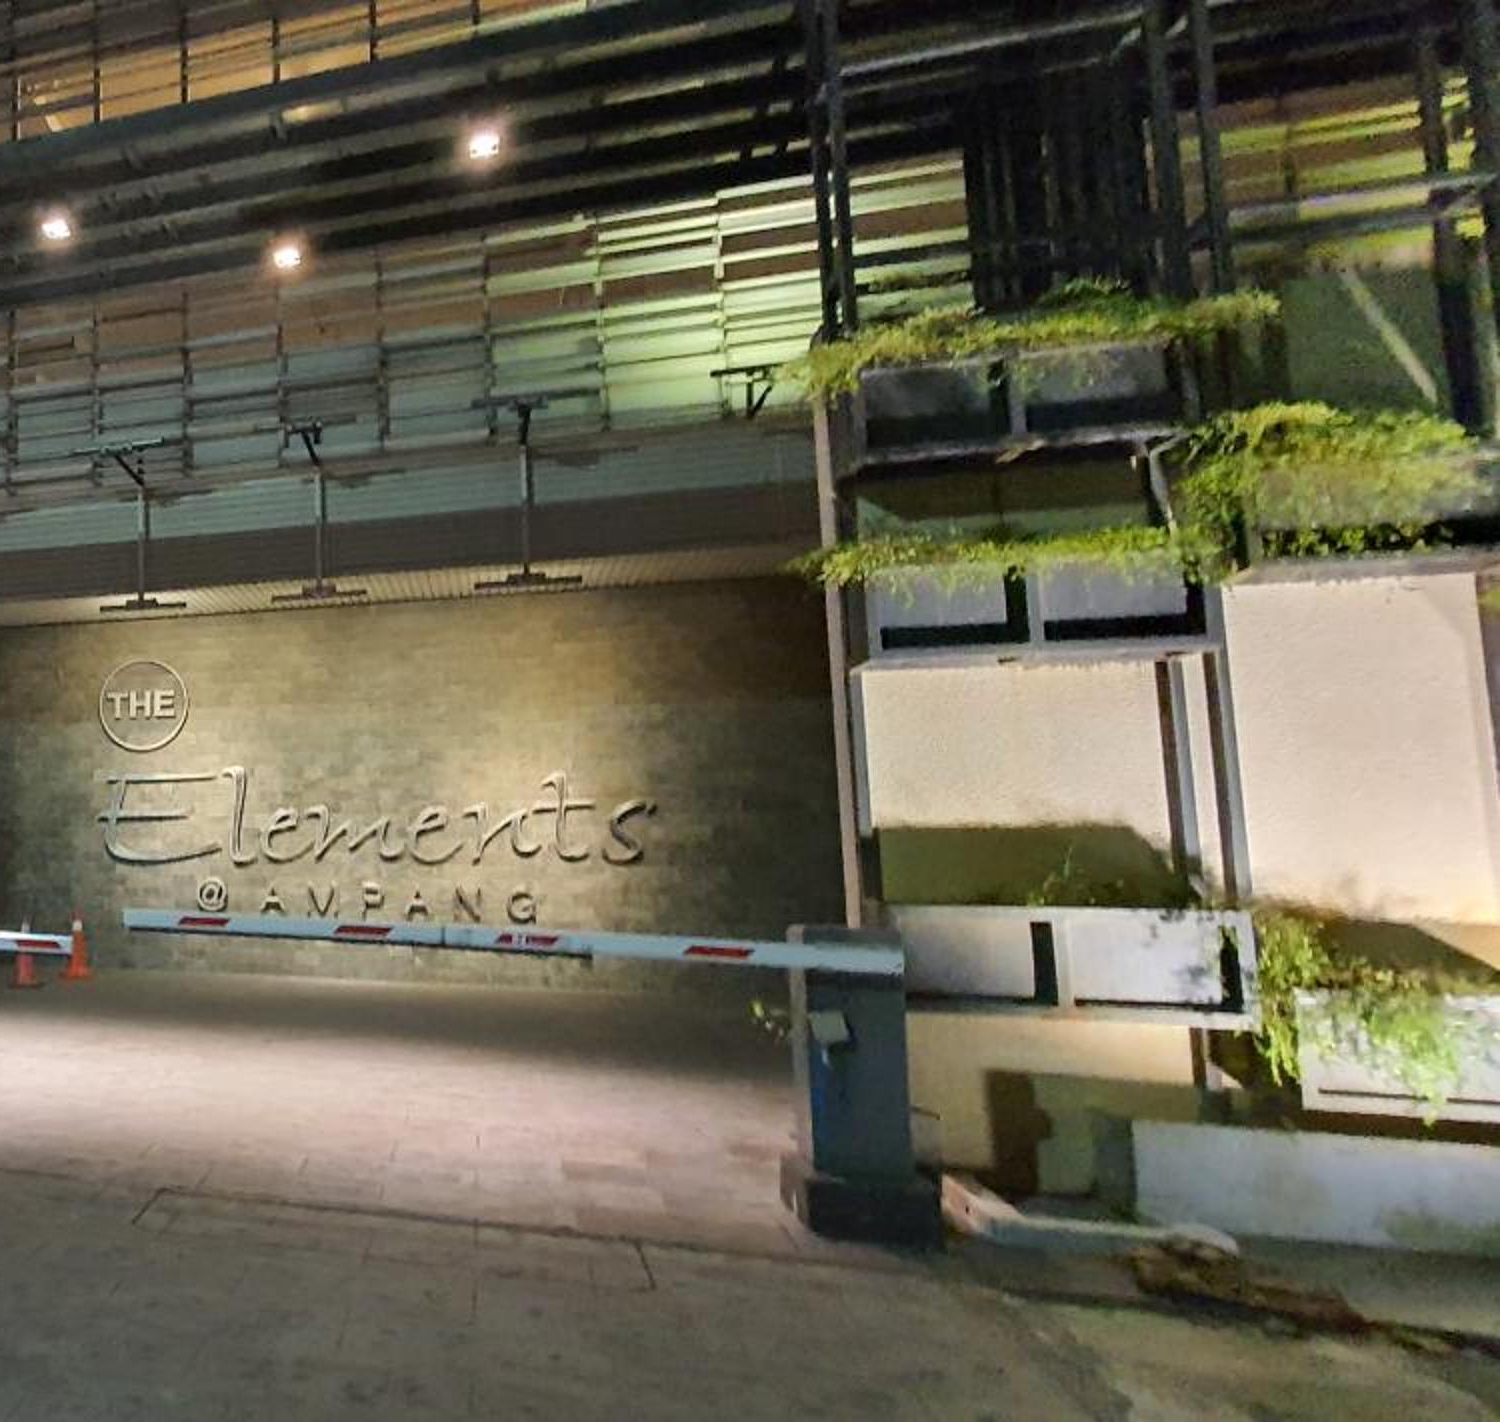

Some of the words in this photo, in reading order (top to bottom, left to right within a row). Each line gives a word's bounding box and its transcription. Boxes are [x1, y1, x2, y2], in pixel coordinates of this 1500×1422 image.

[105, 689, 177, 721] THE
[97, 765, 658, 866] Elements
[197, 876, 228, 912] @
[259, 880, 538, 925] AMPANG
